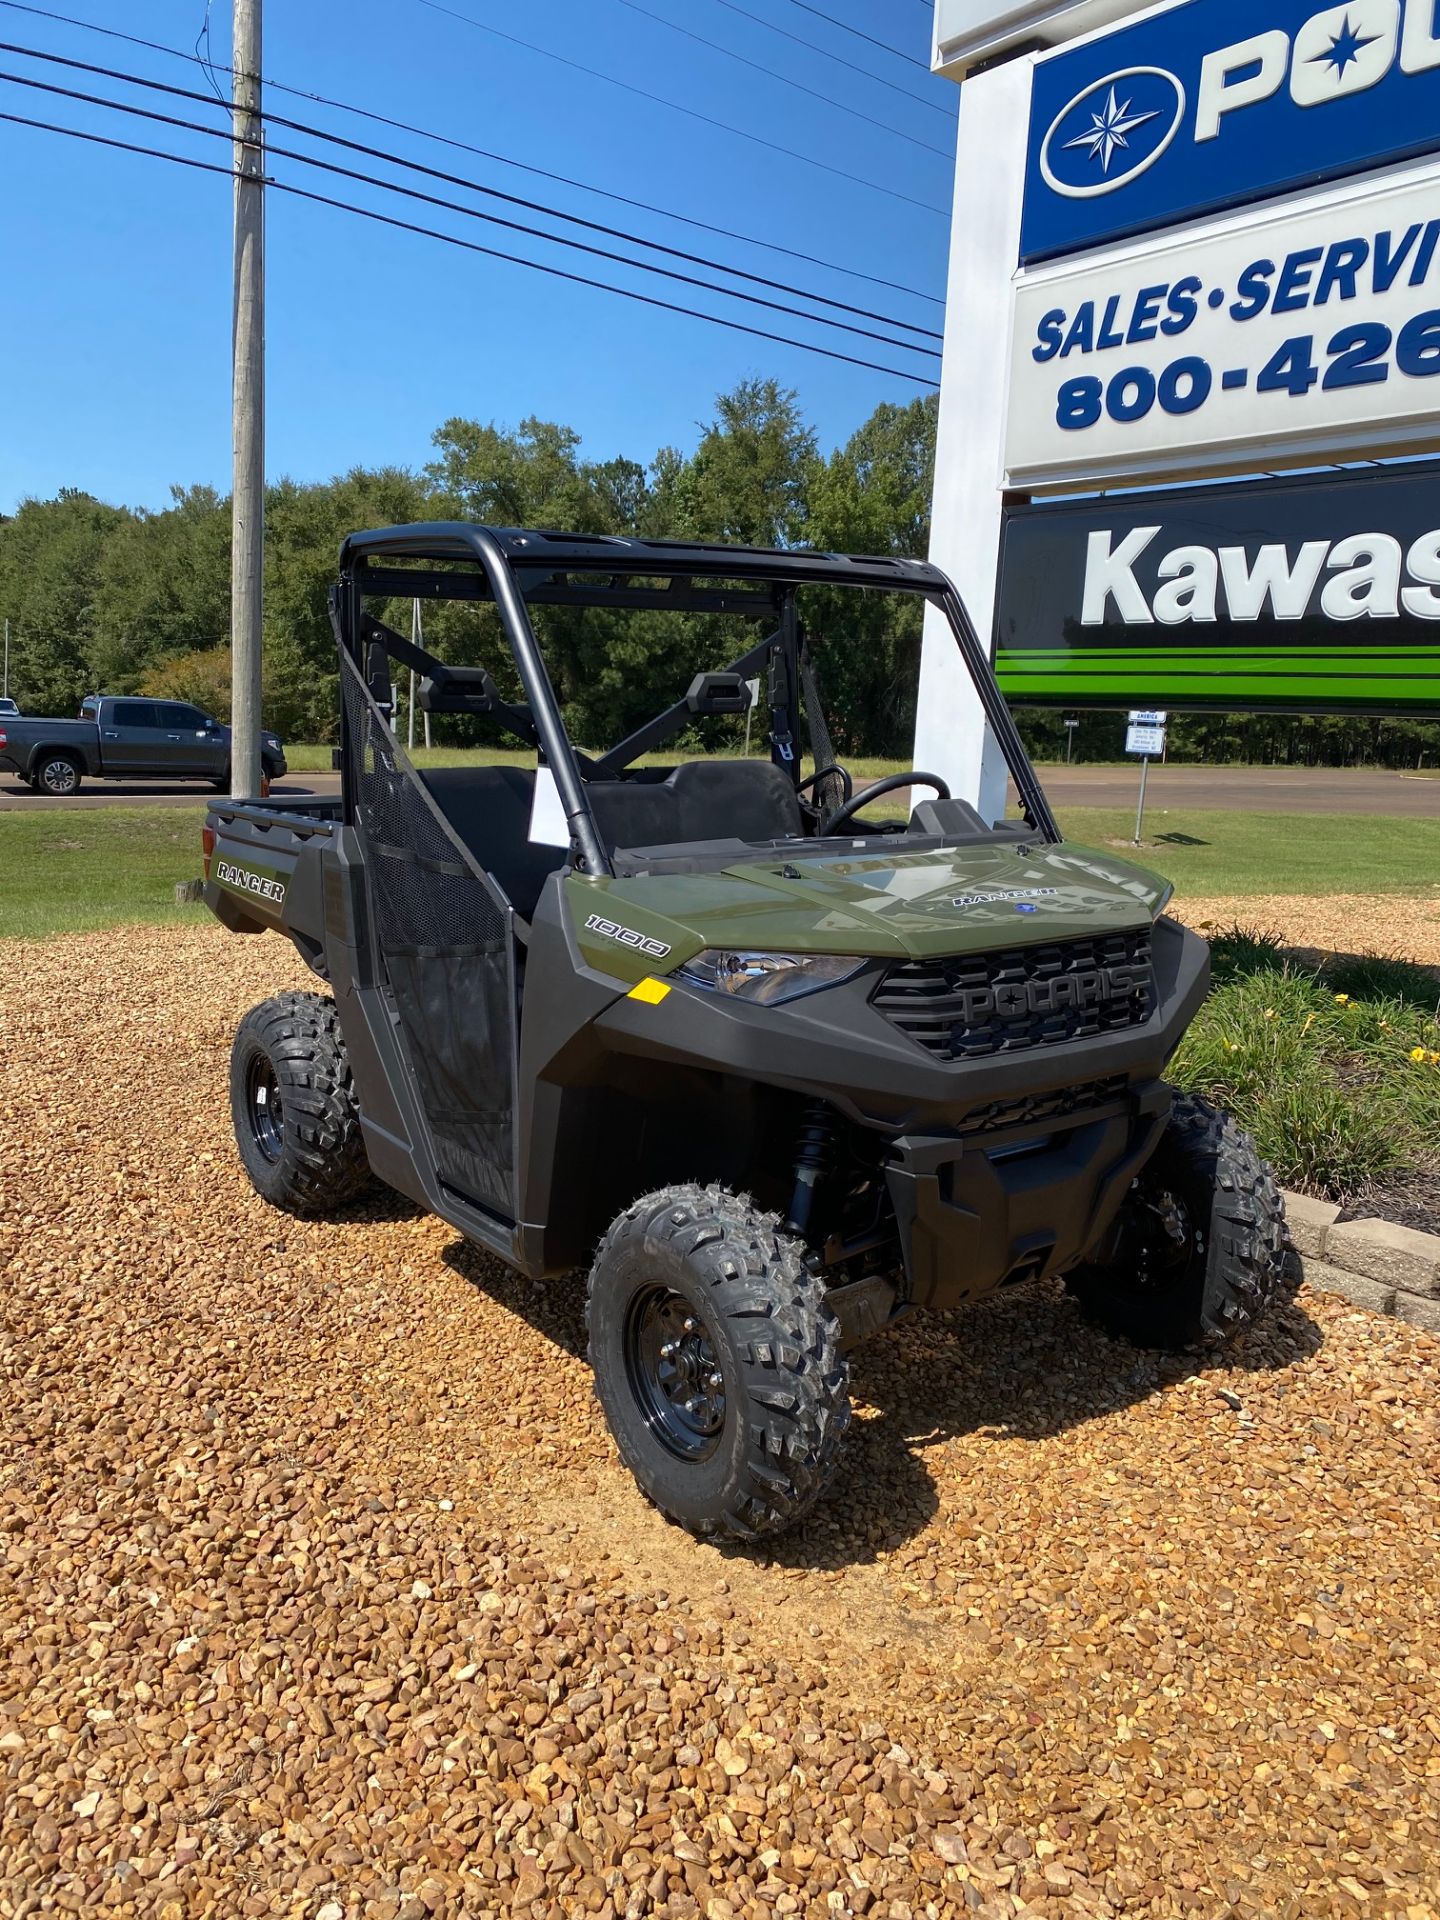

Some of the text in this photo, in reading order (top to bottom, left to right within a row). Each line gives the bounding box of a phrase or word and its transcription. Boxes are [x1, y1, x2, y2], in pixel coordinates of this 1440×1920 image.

[1055, 309, 1440, 430] 800-426
[217, 861, 285, 902] RANGER
[952, 887, 1058, 906] RANGER
[584, 913, 672, 958] 1000
[961, 967, 1135, 1023] POLARIS
